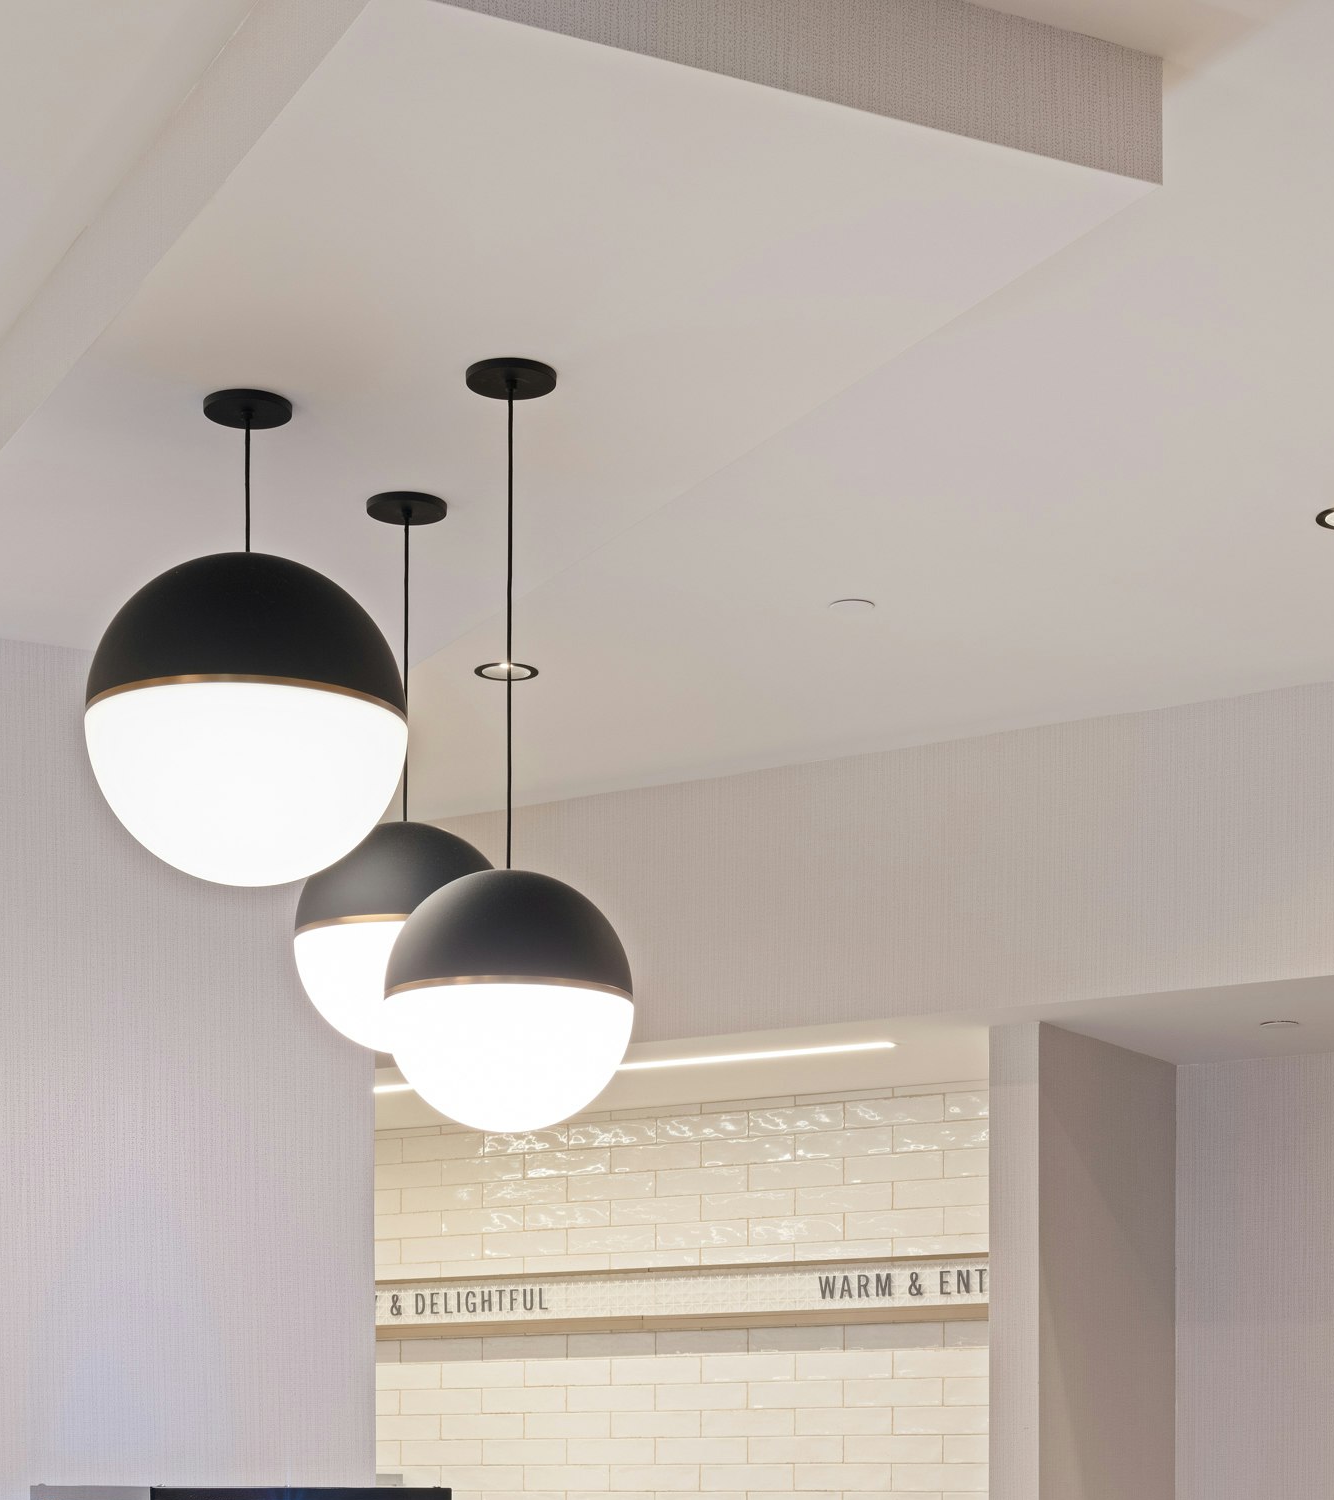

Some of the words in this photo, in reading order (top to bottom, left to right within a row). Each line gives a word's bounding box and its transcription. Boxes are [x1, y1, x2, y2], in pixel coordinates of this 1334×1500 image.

[818, 1272, 893, 1300] WARM
[907, 1271, 924, 1297] &
[390, 1294, 403, 1317] &
[414, 1287, 549, 1316] DELIGHTFUL
